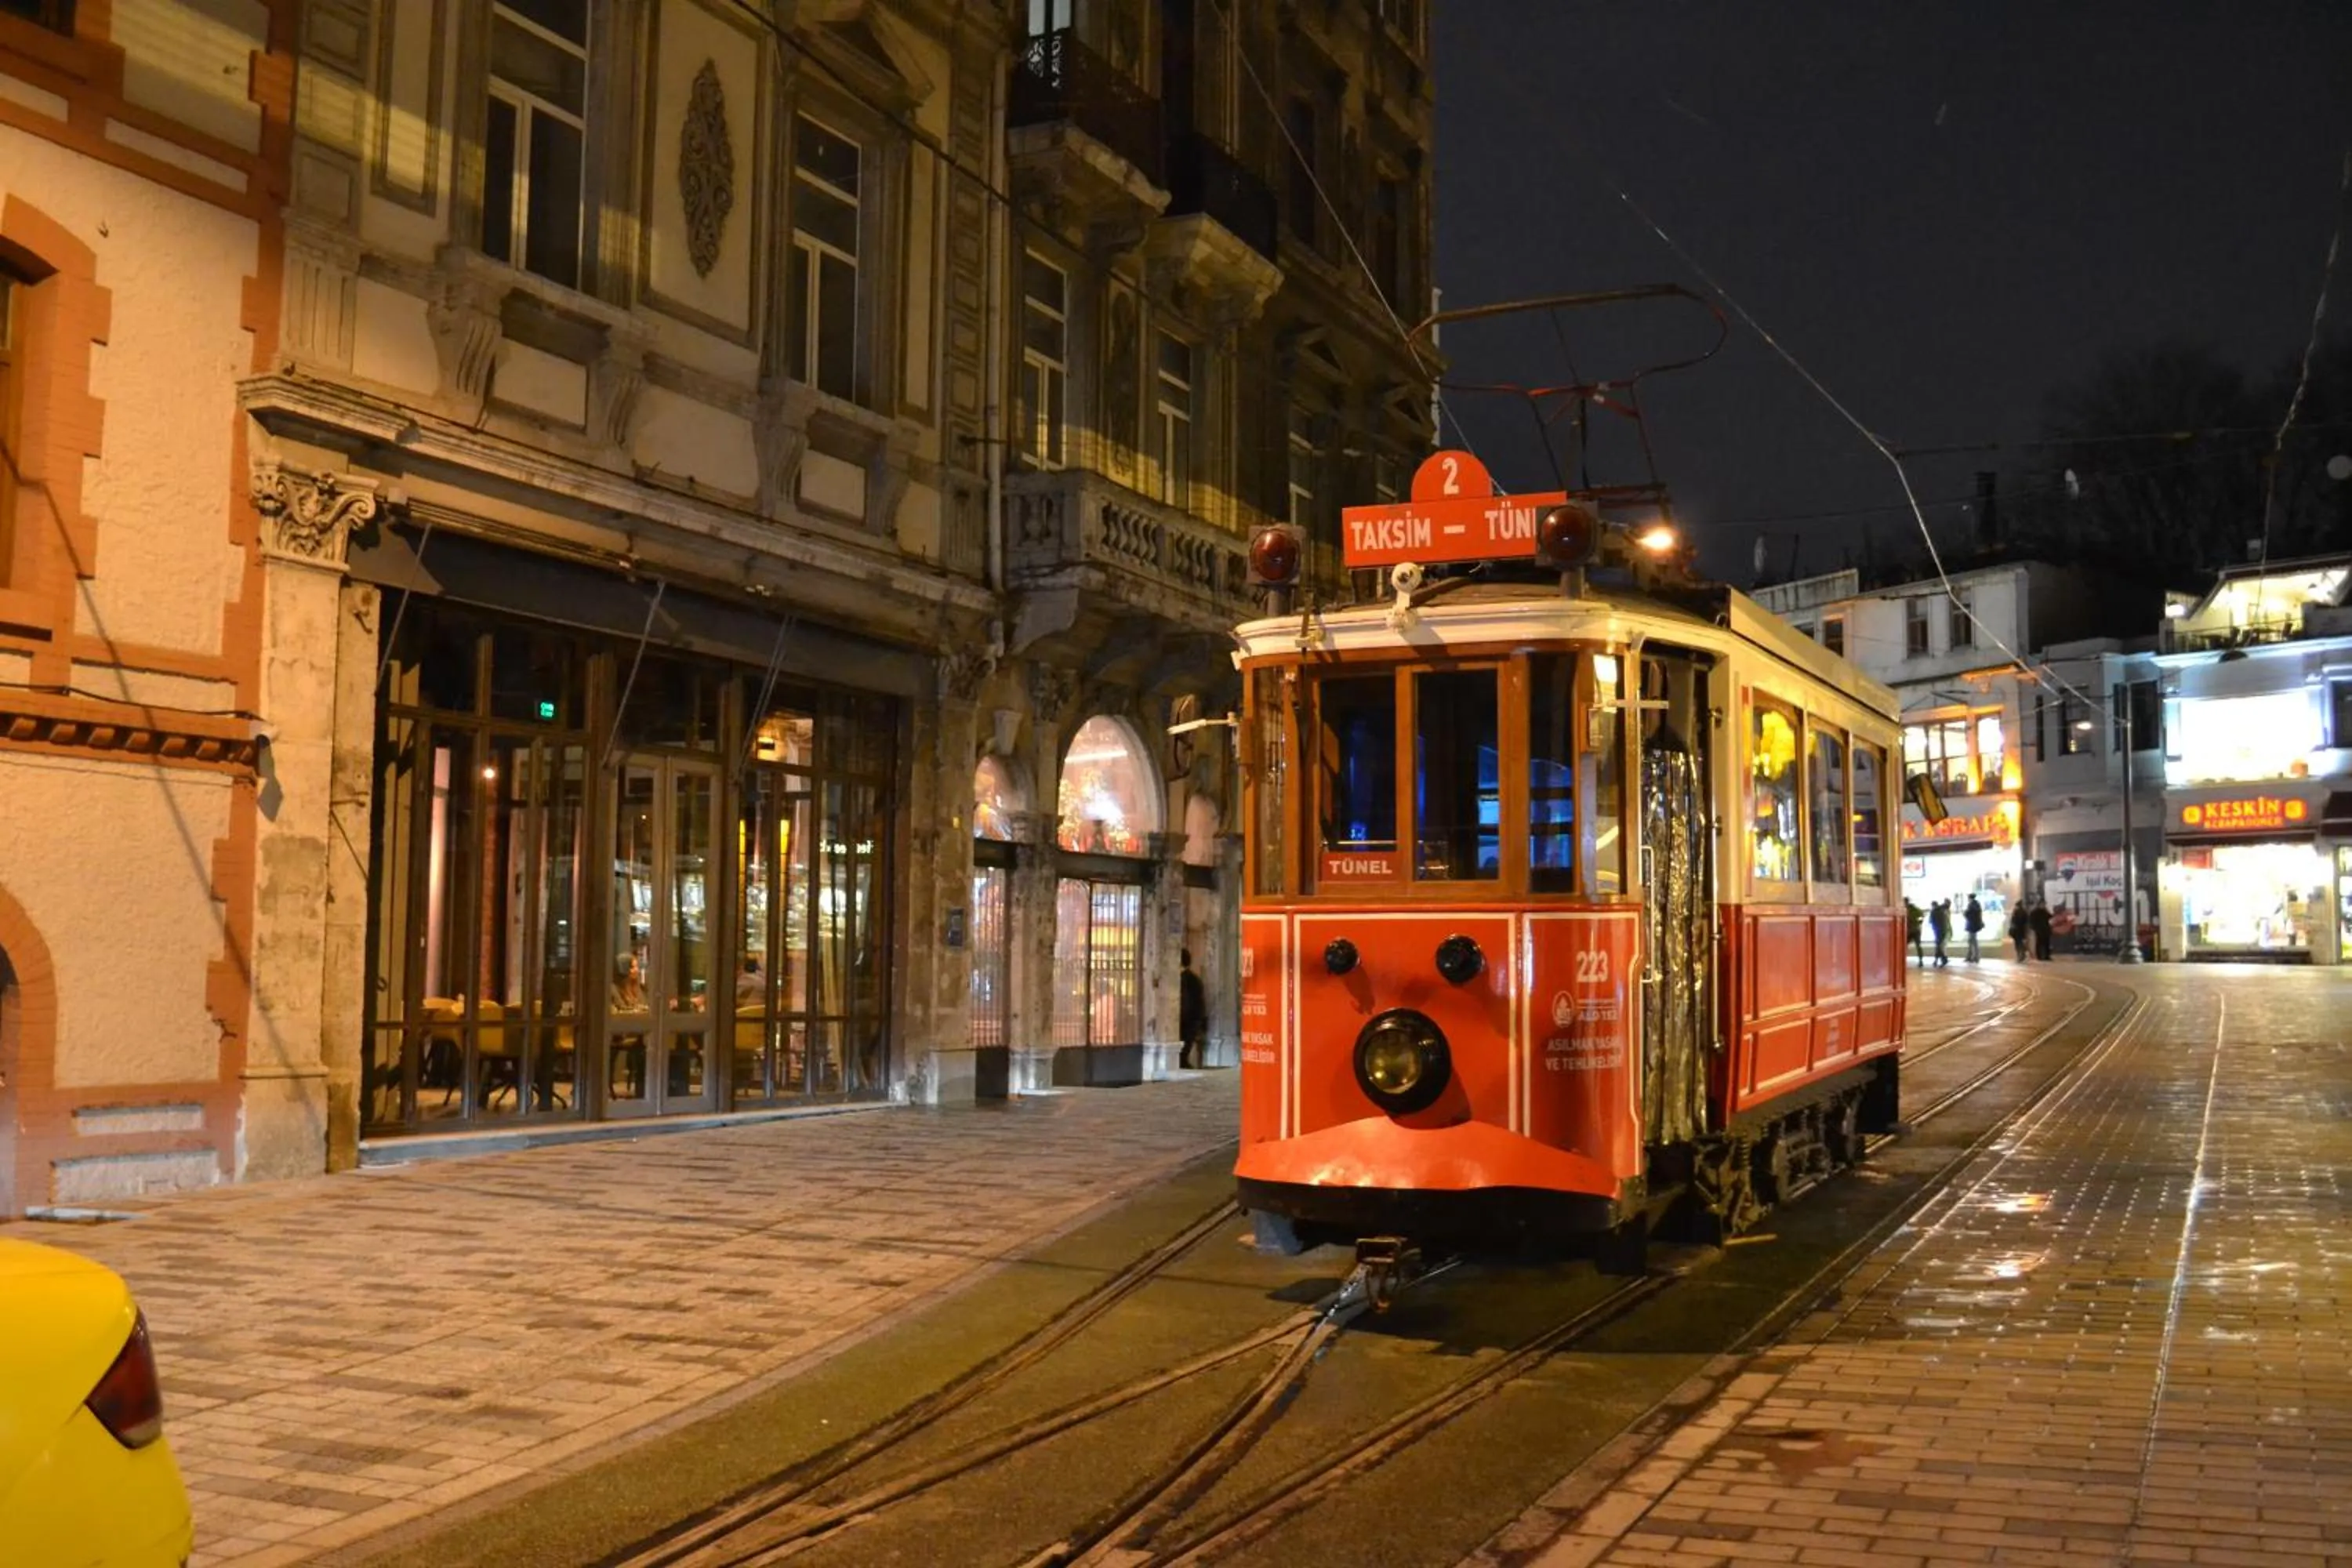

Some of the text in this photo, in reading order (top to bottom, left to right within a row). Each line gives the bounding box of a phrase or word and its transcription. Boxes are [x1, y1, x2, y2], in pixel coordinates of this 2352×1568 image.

[1442, 457, 1460, 495] 2
[1351, 510, 1432, 551] TAKSİM
[1484, 500, 1536, 540] TÜN
[2204, 796, 2281, 818] KESKİN
[1329, 857, 1393, 875] TÜNEL
[1576, 951, 1609, 982] 223
